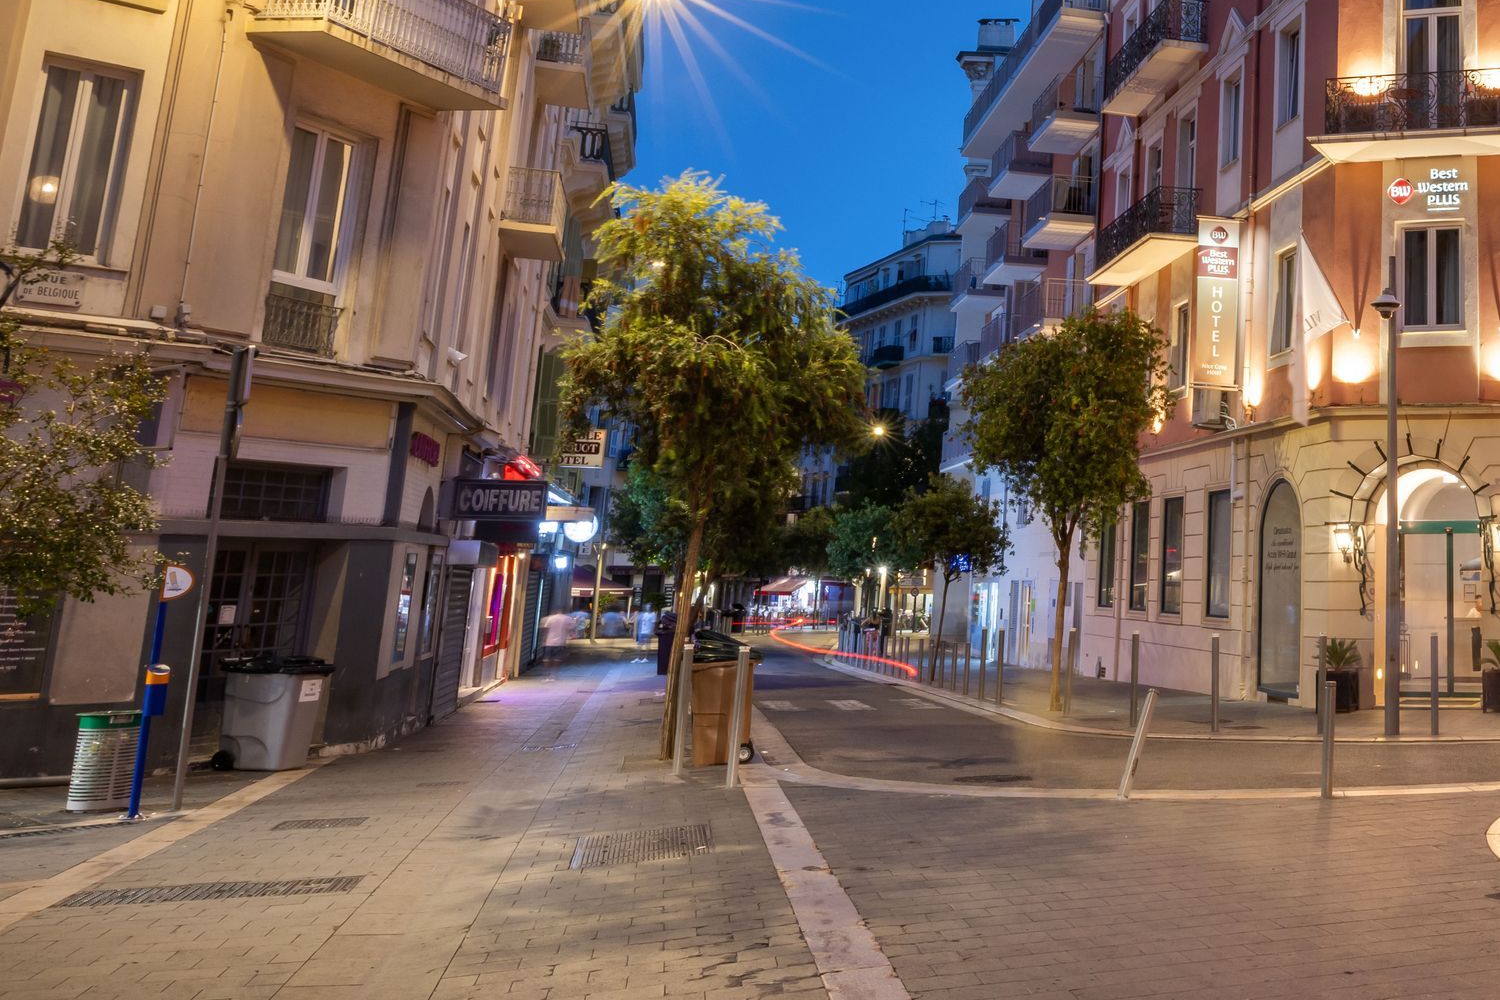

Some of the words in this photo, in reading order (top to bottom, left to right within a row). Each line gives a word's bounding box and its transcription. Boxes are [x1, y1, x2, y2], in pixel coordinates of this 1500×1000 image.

[1430, 168, 1458, 179] Best
[1390, 186, 1411, 198] BW
[1417, 182, 1469, 193] Western
[1427, 194, 1460, 206] PLUS
[1211, 230, 1227, 240] BW
[1210, 249, 1228, 259] Best
[1202, 256, 1235, 266] Western
[37, 286, 80, 300] BELGIQUE
[1211, 286, 1223, 358] HOTEL
[459, 487, 542, 513] COIFFURE
